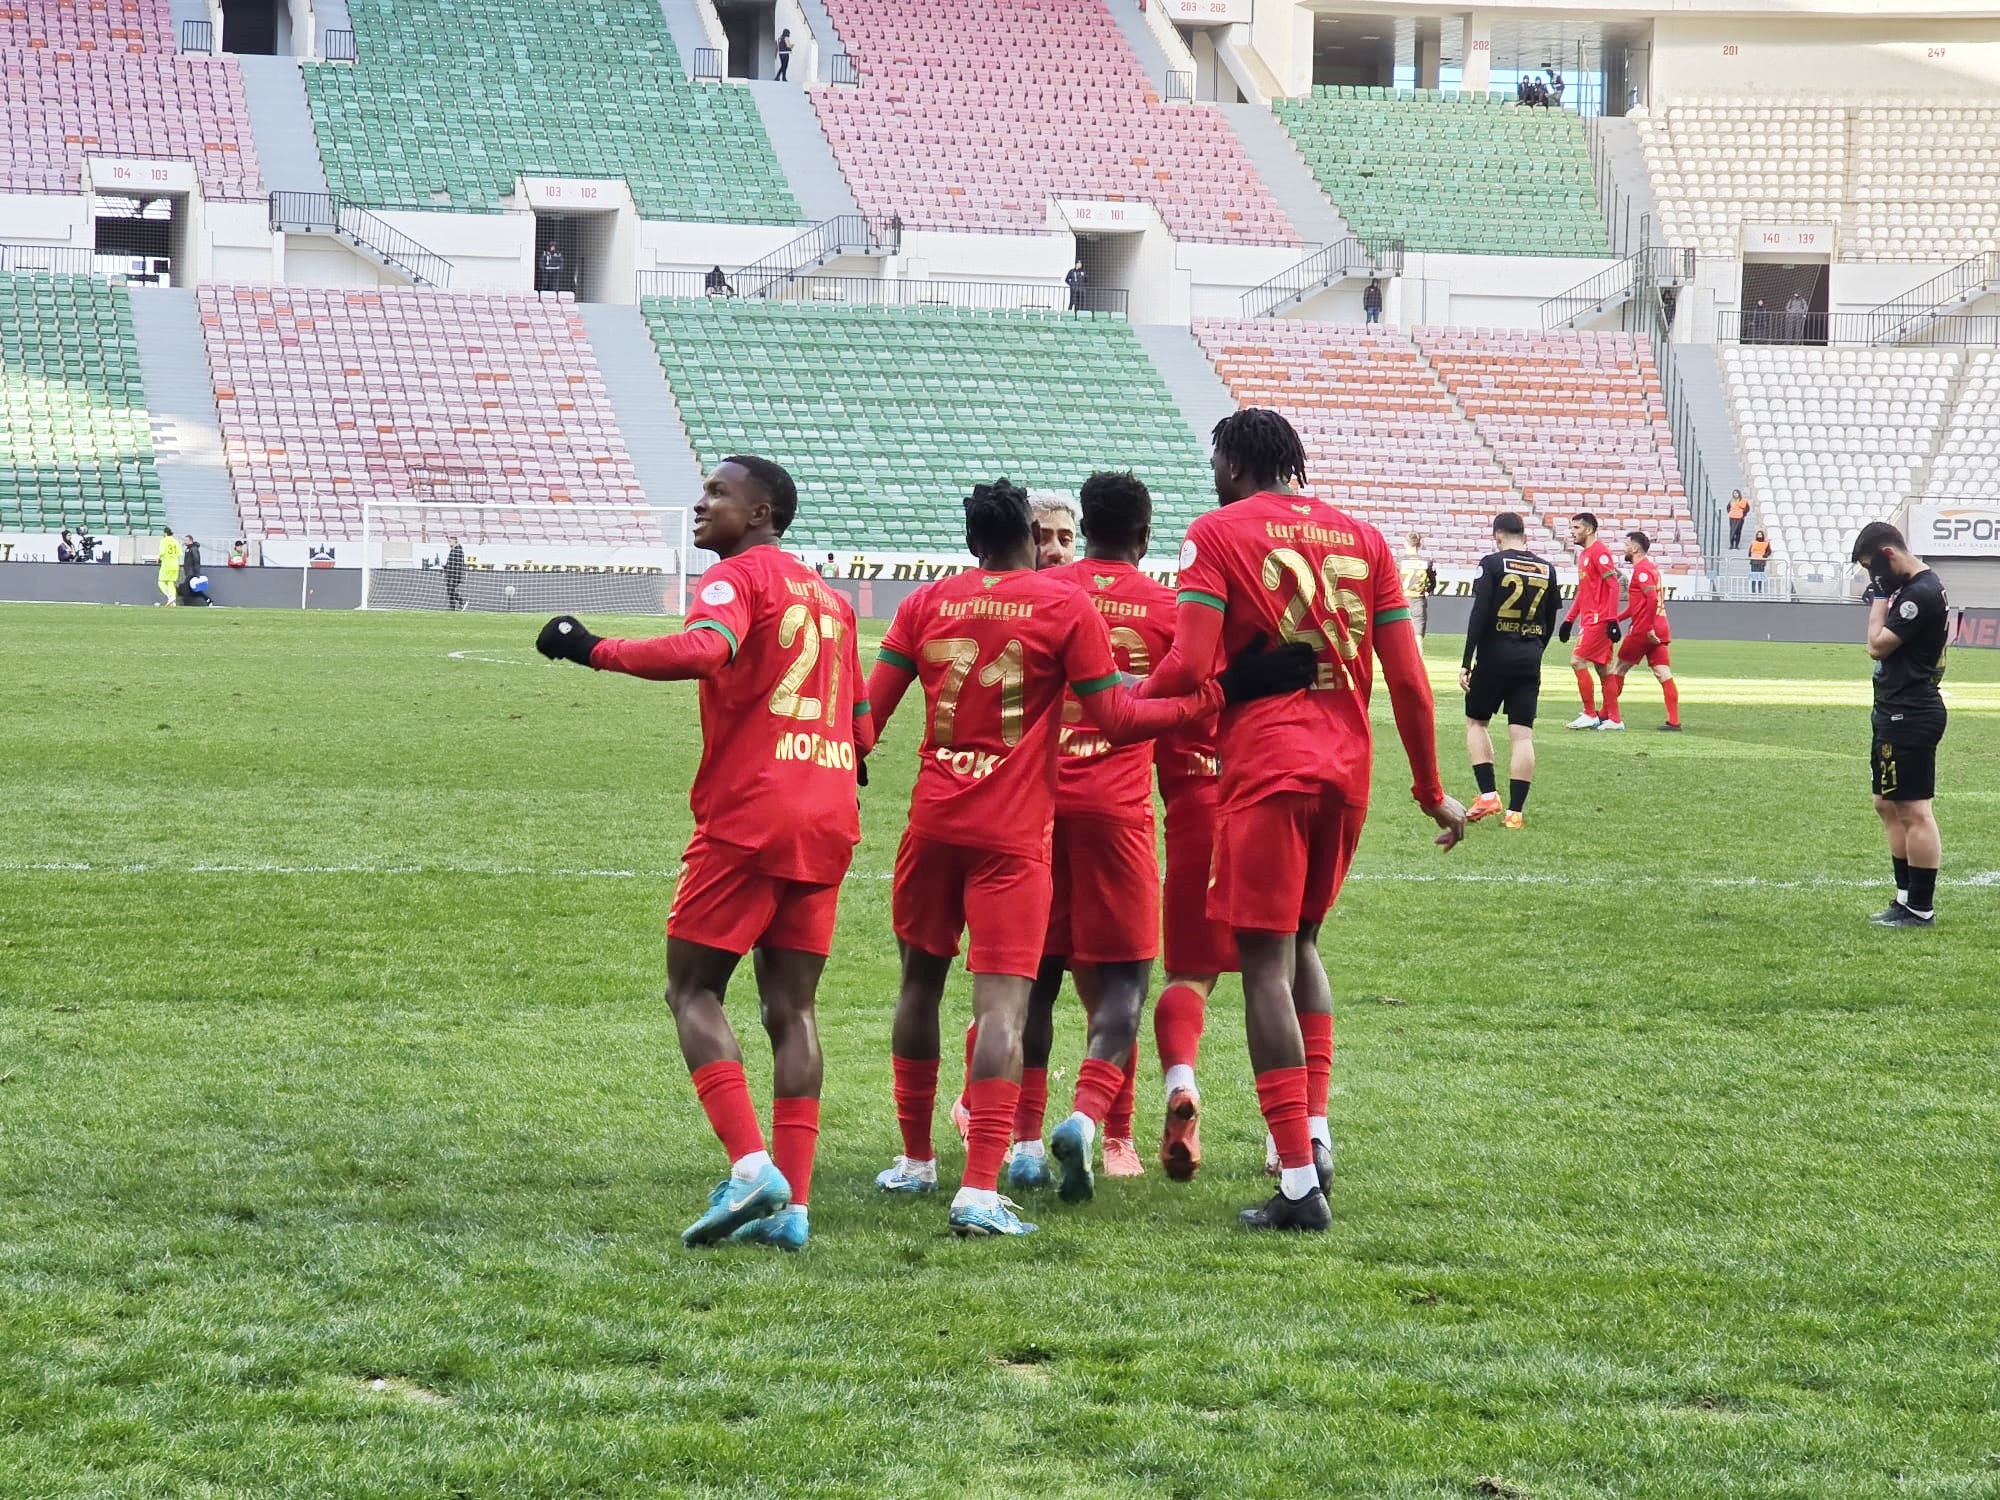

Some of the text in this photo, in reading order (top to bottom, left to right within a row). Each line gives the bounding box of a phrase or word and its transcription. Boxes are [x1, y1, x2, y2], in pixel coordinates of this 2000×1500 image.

[1181, 2, 1226, 13] 203 202
[1473, 40, 1489, 51] 202
[1723, 45, 1738, 56] 201
[1928, 48, 1945, 58] 249
[113, 167, 168, 181] 104 103
[545, 186, 597, 199] 103 102
[1076, 208, 1124, 220] 102 101
[1763, 233, 1815, 244] 140 139
[167, 543, 178, 555] 31
[1497, 573, 1549, 619] 27
[1262, 548, 1369, 660] 25
[769, 604, 844, 728] 27
[923, 637, 1024, 748] 71
[935, 746, 1006, 778] POK
[1880, 760, 1898, 786] 21
